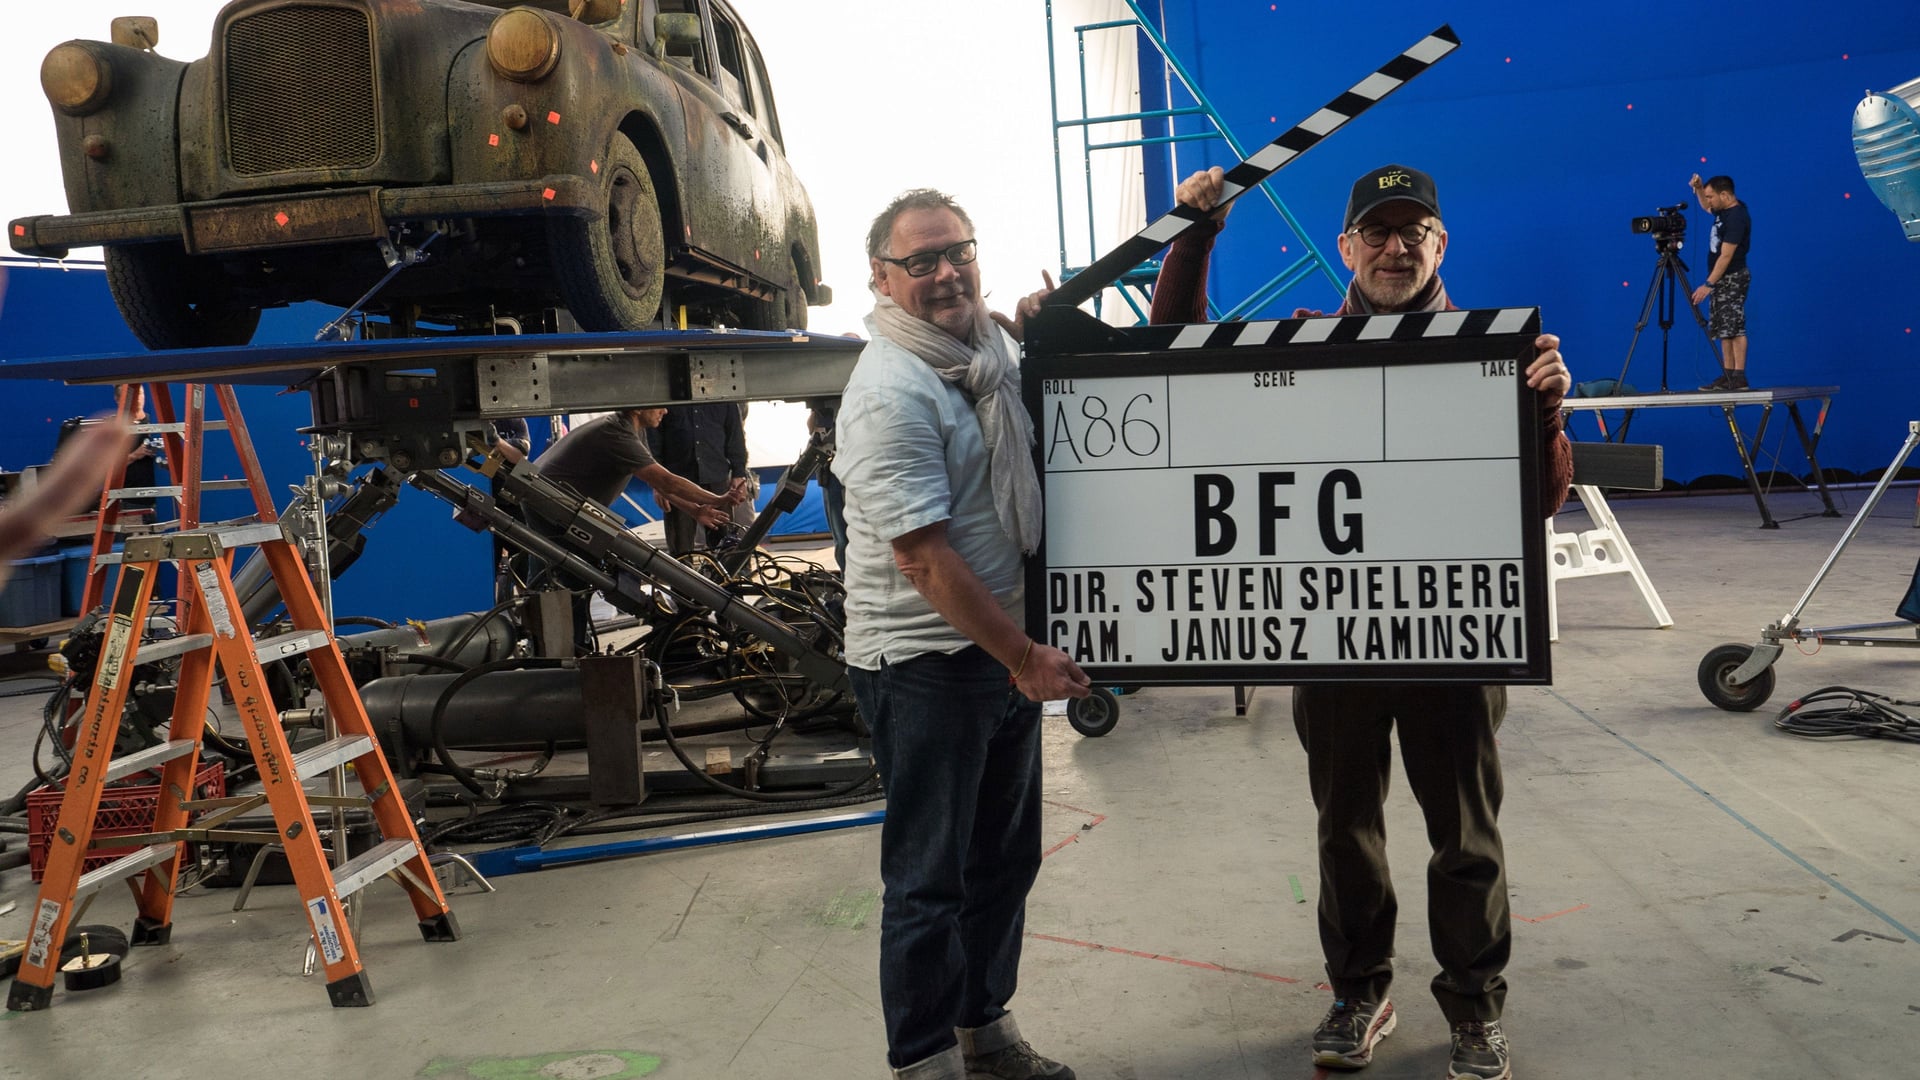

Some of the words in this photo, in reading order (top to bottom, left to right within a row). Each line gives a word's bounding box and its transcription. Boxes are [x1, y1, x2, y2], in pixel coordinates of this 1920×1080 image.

[1378, 174, 1411, 189] BFG
[1254, 371, 1297, 388] SCENE
[1480, 360, 1516, 378] TAKE
[1044, 379, 1076, 396] ROLL
[1047, 393, 1161, 464] A86
[1194, 468, 1365, 558] BFG
[1050, 570, 1120, 614] DIR.
[1136, 566, 1283, 612] STEVEN
[1299, 563, 1521, 611] SPIELBERG
[1051, 619, 1133, 663] CAM.
[1161, 616, 1309, 662] JANUSZ
[1336, 613, 1524, 660] KAMINSKI
